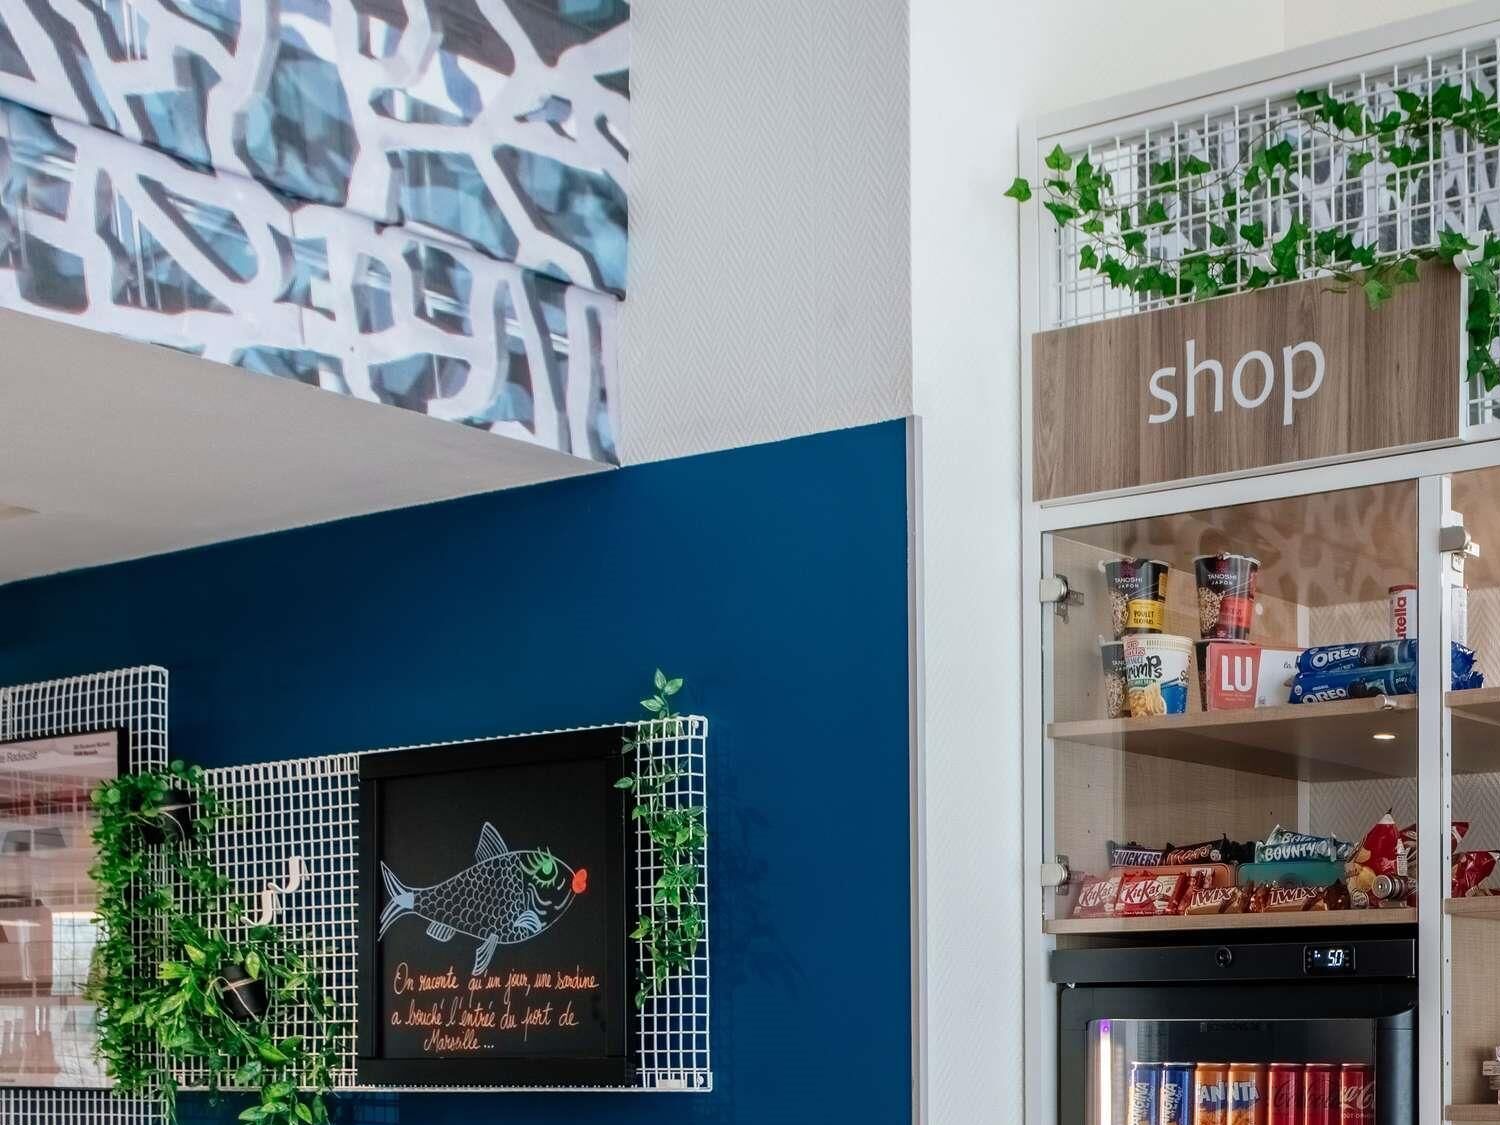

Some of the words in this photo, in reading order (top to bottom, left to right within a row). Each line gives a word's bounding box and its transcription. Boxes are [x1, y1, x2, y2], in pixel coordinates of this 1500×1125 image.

[1148, 339, 1325, 426] shop
[1312, 648, 1359, 667] OREO
[1221, 655, 1252, 691] LU
[1303, 688, 1346, 704] OREO
[1264, 843, 1317, 861] BOUNTY
[1125, 880, 1162, 903] KitKat
[393, 962, 415, 995] On
[418, 965, 459, 992] raconte
[534, 972, 551, 989] une
[555, 964, 600, 991] sardine
[500, 1000, 517, 1030] du
[521, 1005, 553, 1042] port
[558, 1000, 579, 1027] de
